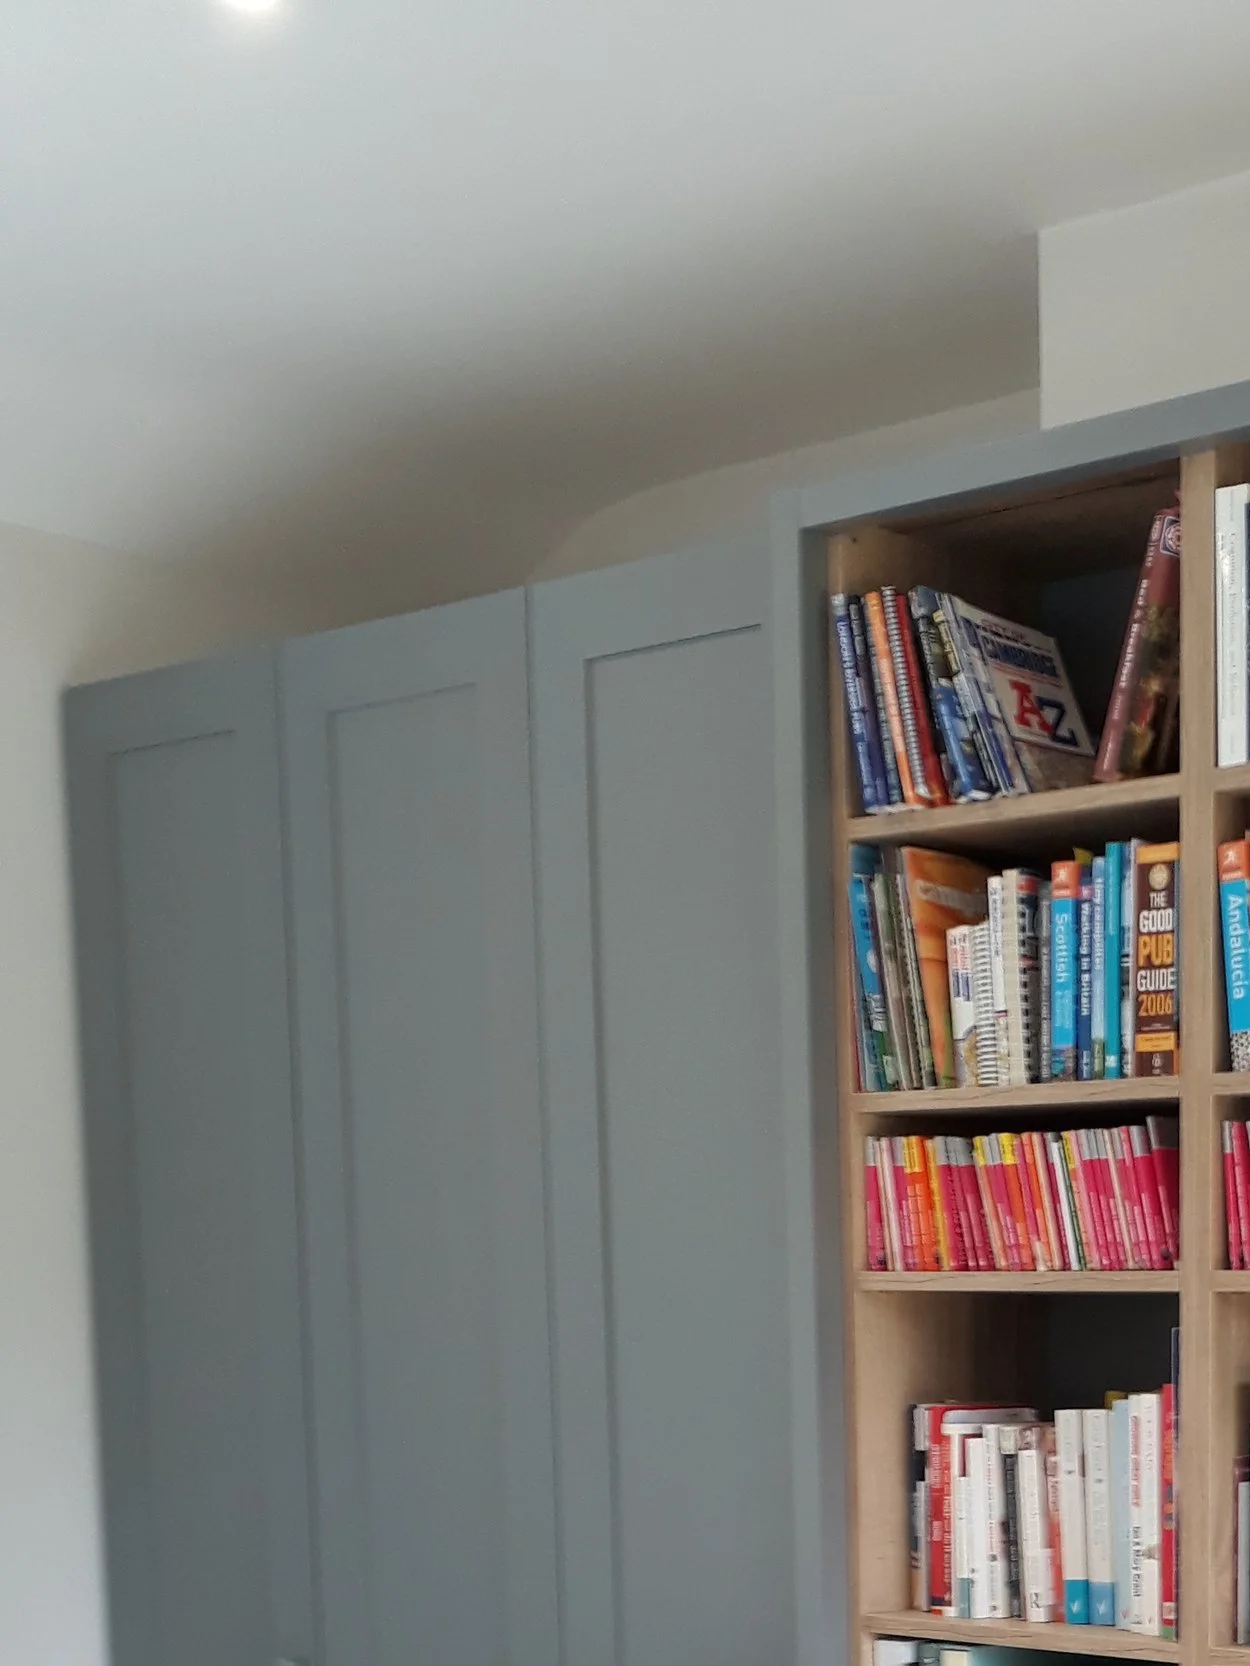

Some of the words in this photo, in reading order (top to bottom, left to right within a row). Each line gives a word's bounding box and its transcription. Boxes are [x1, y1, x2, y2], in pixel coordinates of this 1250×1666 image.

[1149, 891, 1168, 908] THE
[1079, 903, 1091, 955] Walking
[1139, 908, 1174, 933] GOOD
[1055, 913, 1070, 983] Scottish
[1138, 933, 1174, 968] PUB
[1227, 894, 1250, 999] Andalucía
[1079, 972, 1091, 1016] Britain
[1137, 968, 1176, 992] GUIDE
[1138, 993, 1173, 1016] 2006
